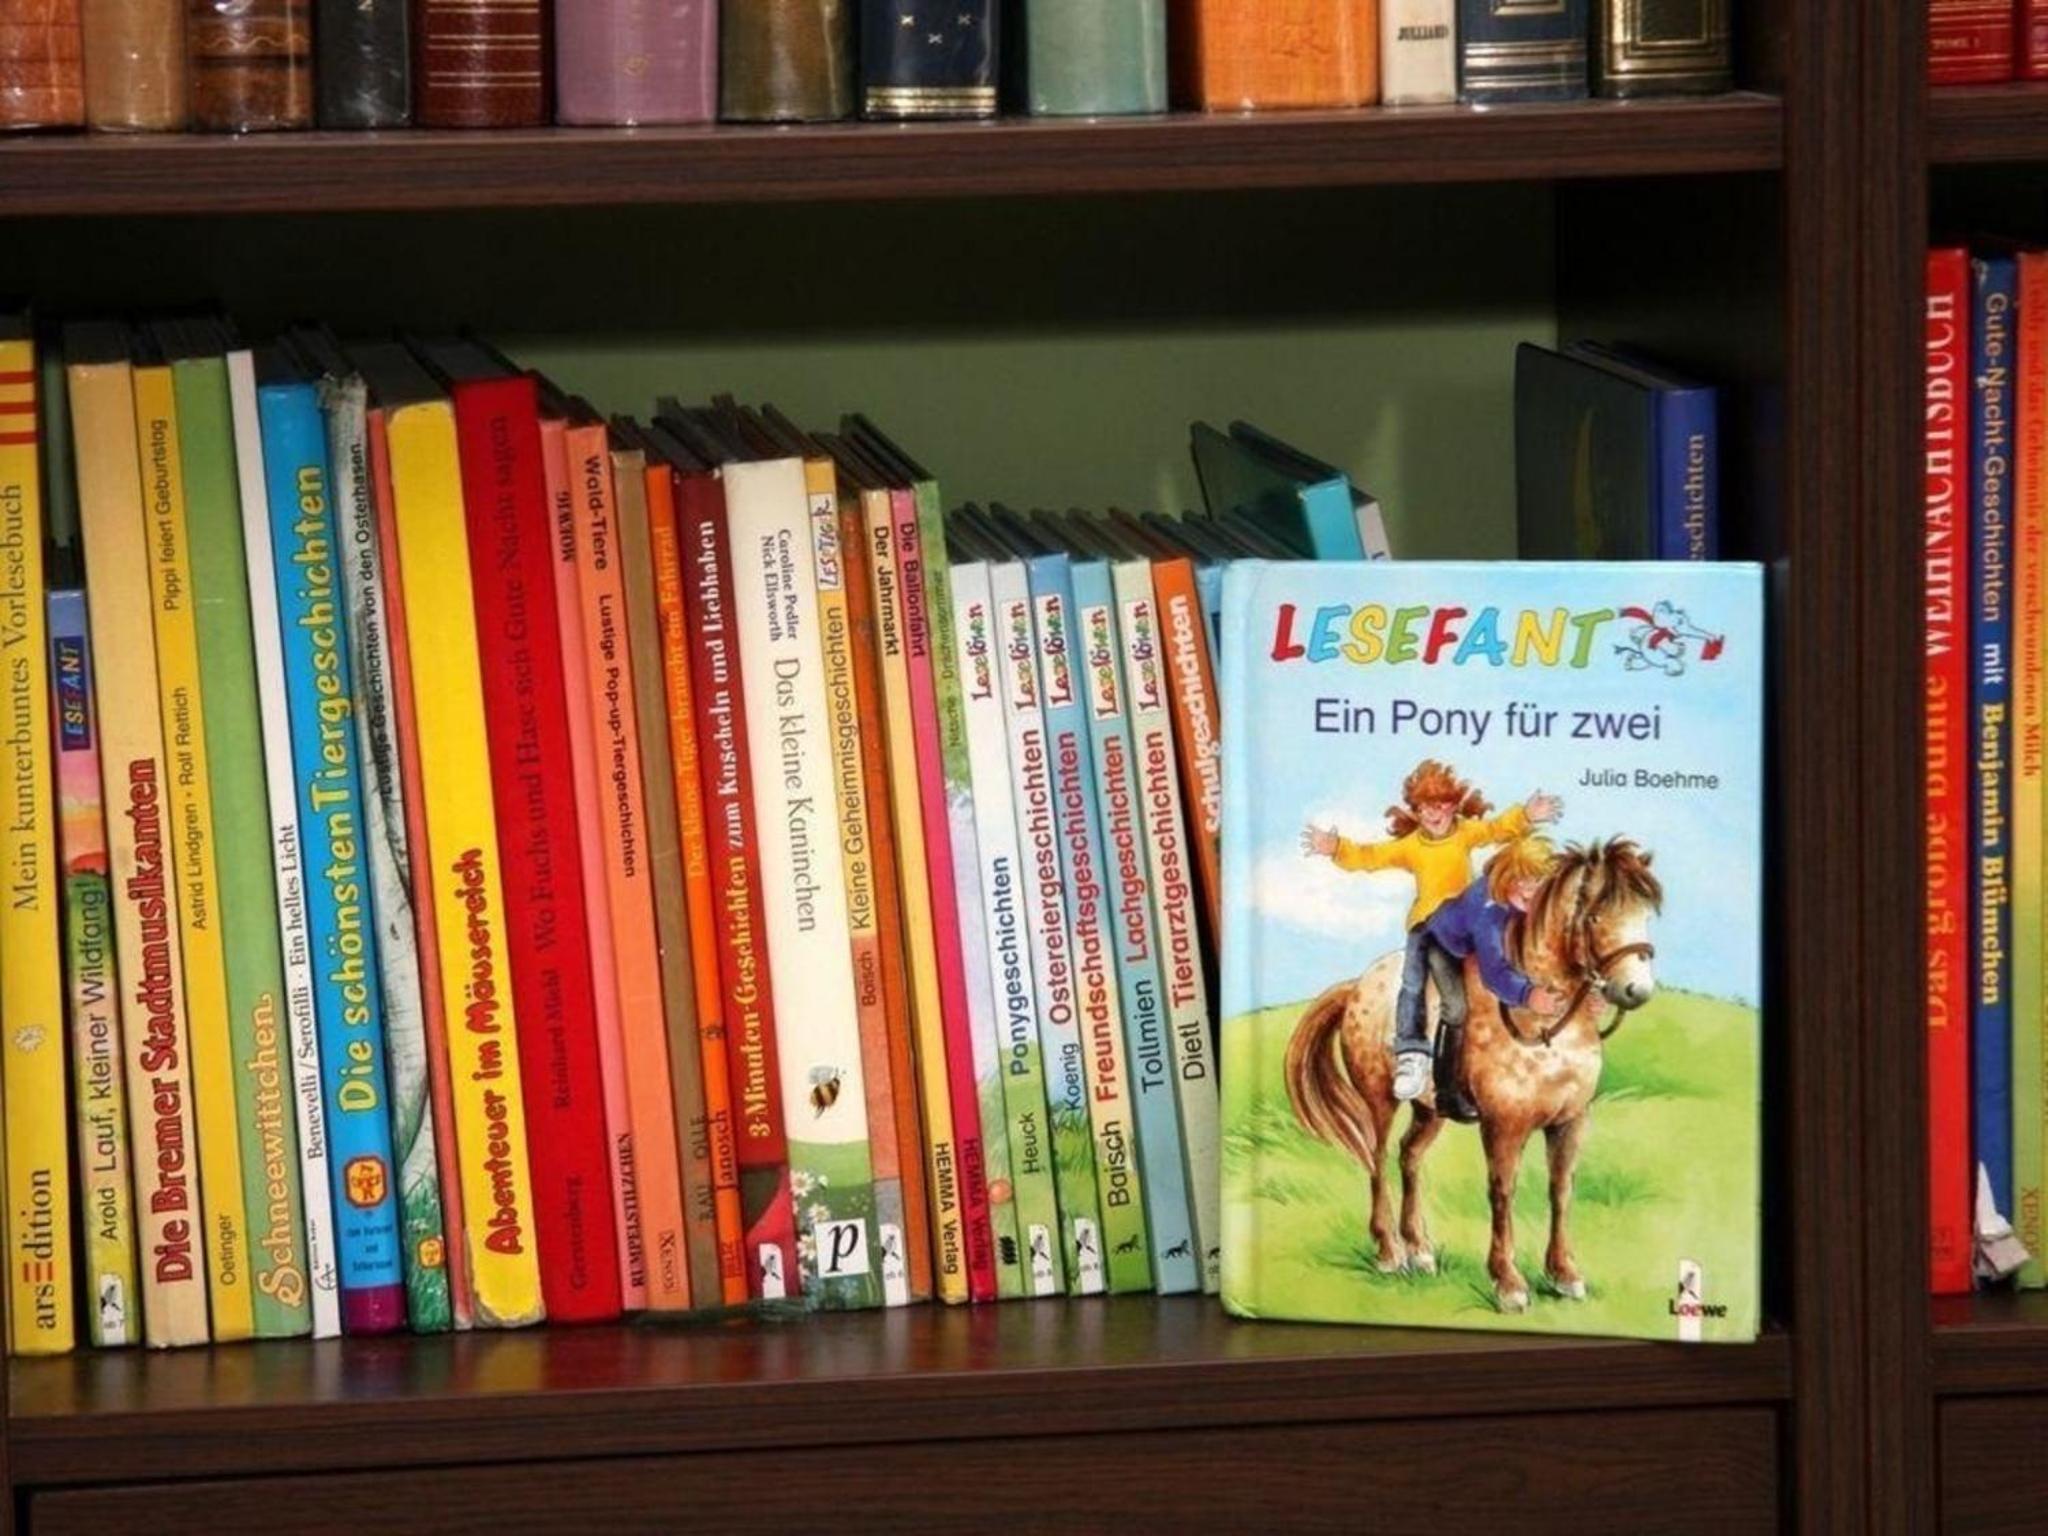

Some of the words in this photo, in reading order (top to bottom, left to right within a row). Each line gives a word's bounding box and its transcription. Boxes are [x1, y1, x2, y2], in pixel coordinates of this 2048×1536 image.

[149, 418, 174, 516] Geburtstag
[348, 442, 370, 544] Osterhasen
[1982, 292, 2009, 622] Gute-Nacht-Geschichten
[556, 490, 576, 564] MOEWIG
[584, 454, 609, 571] Wald-Tiere
[1683, 434, 1705, 562] schichten
[0, 484, 29, 648] Vorlesebuch
[156, 519, 176, 564] feiert
[356, 548, 374, 580] den
[654, 524, 679, 603] Fahrrad
[761, 534, 777, 570] Nick
[777, 528, 795, 590] Caroline
[873, 525, 890, 559] Der
[899, 522, 917, 553] Die
[160, 567, 182, 611] Pippi
[362, 586, 376, 617] von
[499, 578, 529, 641] Gute
[697, 520, 724, 632] Liebhaben
[763, 572, 782, 642] Ellsworth
[877, 565, 900, 657] Jahrmarkt
[902, 559, 927, 659] Ballonfahrt
[293, 466, 350, 813] Tiergeschichten
[598, 593, 619, 661] Lustige
[705, 638, 729, 684] und
[966, 602, 993, 702] Leselöwen
[1006, 601, 1037, 711] Leselöwen
[1043, 595, 1073, 705] Leselöwen
[1088, 607, 1118, 717] Leselöwen
[1130, 601, 1161, 710] Leselöwen
[1270, 603, 1614, 668] LESEFANT
[1982, 643, 2005, 685] mit
[364, 621, 388, 729] Geschichten
[507, 647, 535, 697] sich
[772, 658, 800, 707] Das
[5, 657, 37, 833] kunterbuntes
[172, 686, 191, 747] Rettich
[513, 703, 540, 766] Hase
[678, 726, 697, 774] Tiger
[708, 689, 739, 796] Kuscheln
[779, 713, 806, 790] kleine
[824, 606, 864, 856] Geheimnisgeschichten
[1313, 698, 1375, 735] Ein
[1391, 699, 1492, 745] Pony
[1505, 703, 1559, 739] für
[1571, 706, 1661, 740] zwei
[178, 749, 195, 787] Rolf
[518, 770, 545, 822] und
[603, 667, 636, 879] Pop-up-Tiergeschichten
[1579, 768, 1626, 788] Julia
[1634, 769, 1719, 789] Boehme
[1979, 703, 2005, 847] Benjamin
[183, 802, 204, 878] Lindgren
[681, 782, 703, 837] kleine
[724, 802, 744, 849] zum
[12, 841, 39, 912] Mein
[278, 823, 299, 872] Licht
[524, 825, 555, 902] Fuchs
[787, 796, 821, 933] Kaninchen
[1022, 730, 1073, 1026] Ostereiergeschichten
[1102, 735, 1148, 964] Lachgeschichten
[1143, 731, 1197, 1009] Tierarztgeschichten
[124, 757, 179, 1073] Stadtmusikanten
[189, 881, 208, 930] Astrid
[282, 876, 303, 930] helles
[325, 812, 370, 1025] schönsten
[532, 909, 558, 953] Wo
[849, 860, 872, 930] Kleine
[1057, 731, 1119, 1101] Freundschaftsgeschichten
[1981, 855, 2007, 1005] Blümchen
[75, 880, 106, 1006] Wildfang!
[290, 934, 306, 968] Ein
[451, 848, 502, 1034] Mäusereich
[989, 857, 1030, 1077] Ponygeschichten
[726, 855, 771, 1138] 3-Minuten-Geschichten
[86, 1012, 112, 1100] kleiner
[472, 1040, 502, 1081] im
[1133, 979, 1164, 1094] Tollmien
[1178, 1020, 1206, 1081] Dietl
[338, 1040, 380, 1112] Die
[1059, 1043, 1082, 1112] Koenig
[90, 1107, 117, 1173] Lauf,
[150, 1077, 189, 1215] Bremer
[302, 1074, 325, 1160] Benevelli
[703, 1108, 740, 1192] Janosch
[1019, 1112, 1041, 1175] Heuck
[483, 1090, 523, 1256] Abenteuer
[934, 1142, 955, 1211] HEMMA
[1101, 1119, 1131, 1208] Baisch
[97, 1186, 118, 1241] Arold
[617, 1132, 645, 1288] RUMPELSTILZCHEN
[153, 1219, 192, 1284] Die
[216, 1213, 238, 1287] Oetinger
[825, 1224, 859, 1273] p
[940, 1220, 960, 1276] Verlag
